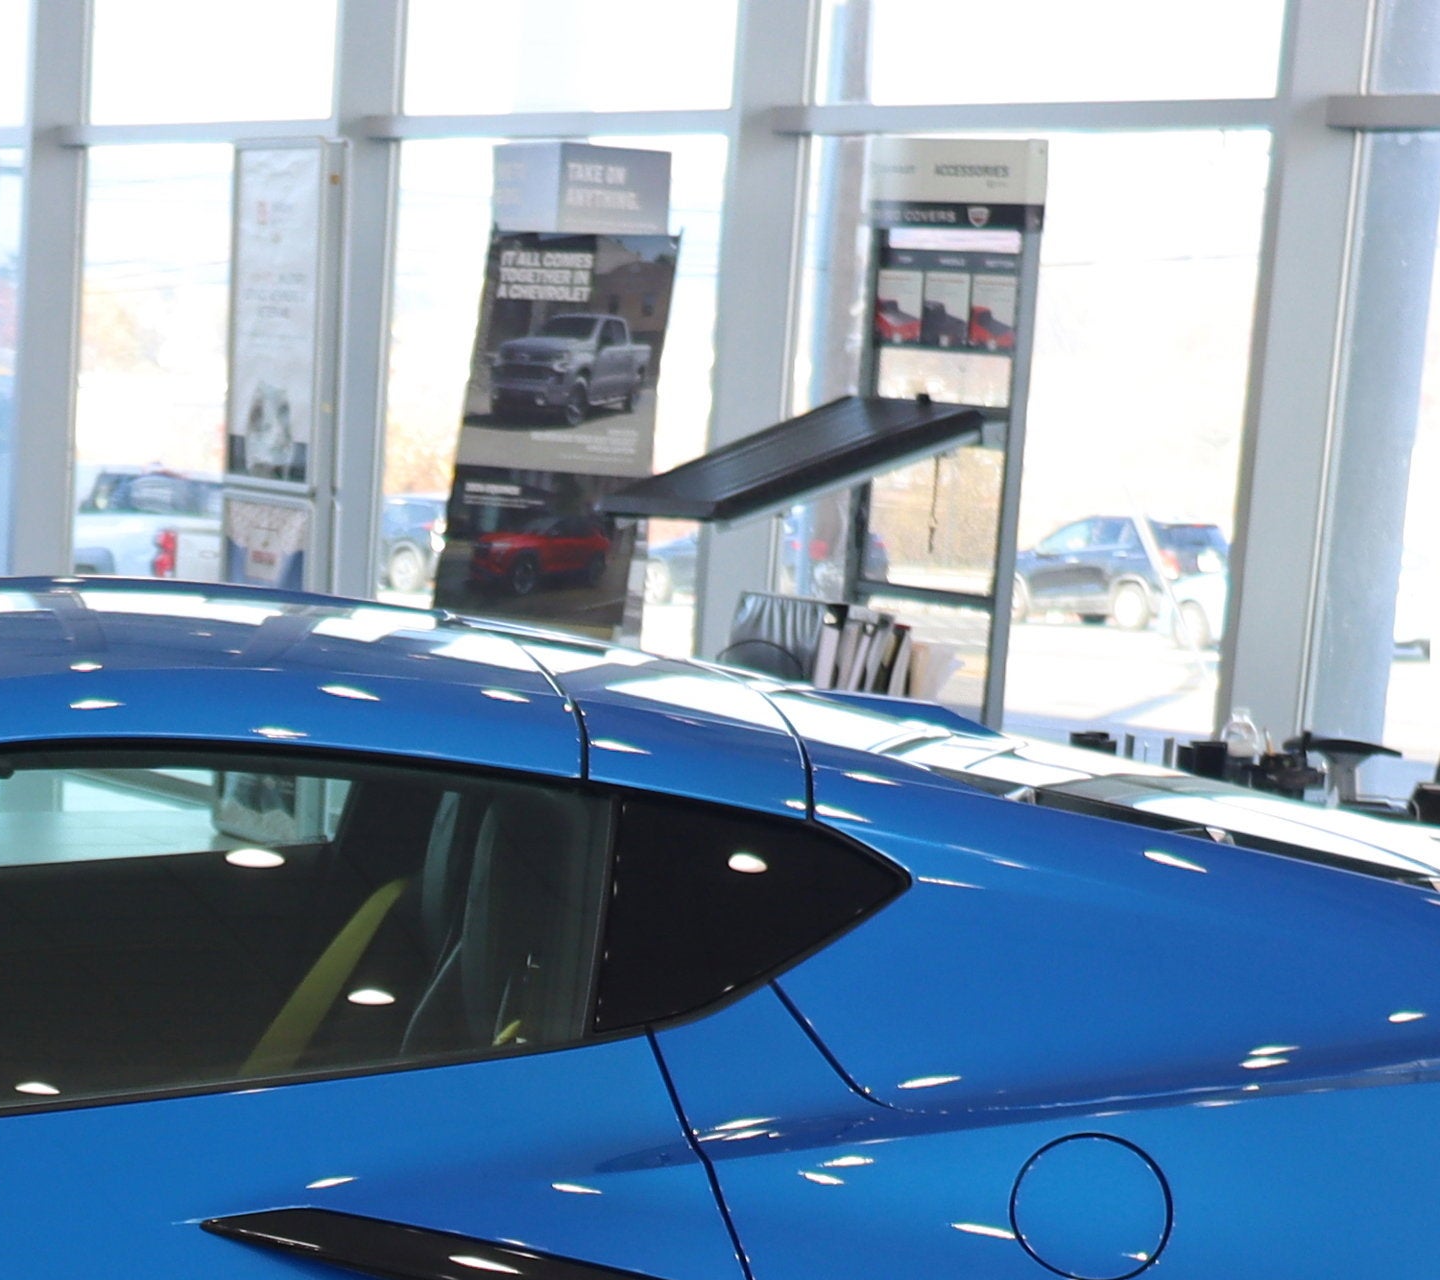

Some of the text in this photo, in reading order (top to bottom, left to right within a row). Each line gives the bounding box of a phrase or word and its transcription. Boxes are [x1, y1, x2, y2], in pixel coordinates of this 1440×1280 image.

[567, 162, 604, 184] TAKE
[935, 164, 1009, 178] ACCESSORIES
[904, 209, 957, 223] COVERS
[516, 251, 541, 267] ALL
[542, 252, 593, 269] COMES
[499, 267, 590, 285] TOGETHER IN
[508, 285, 591, 303] CHEVROLET
